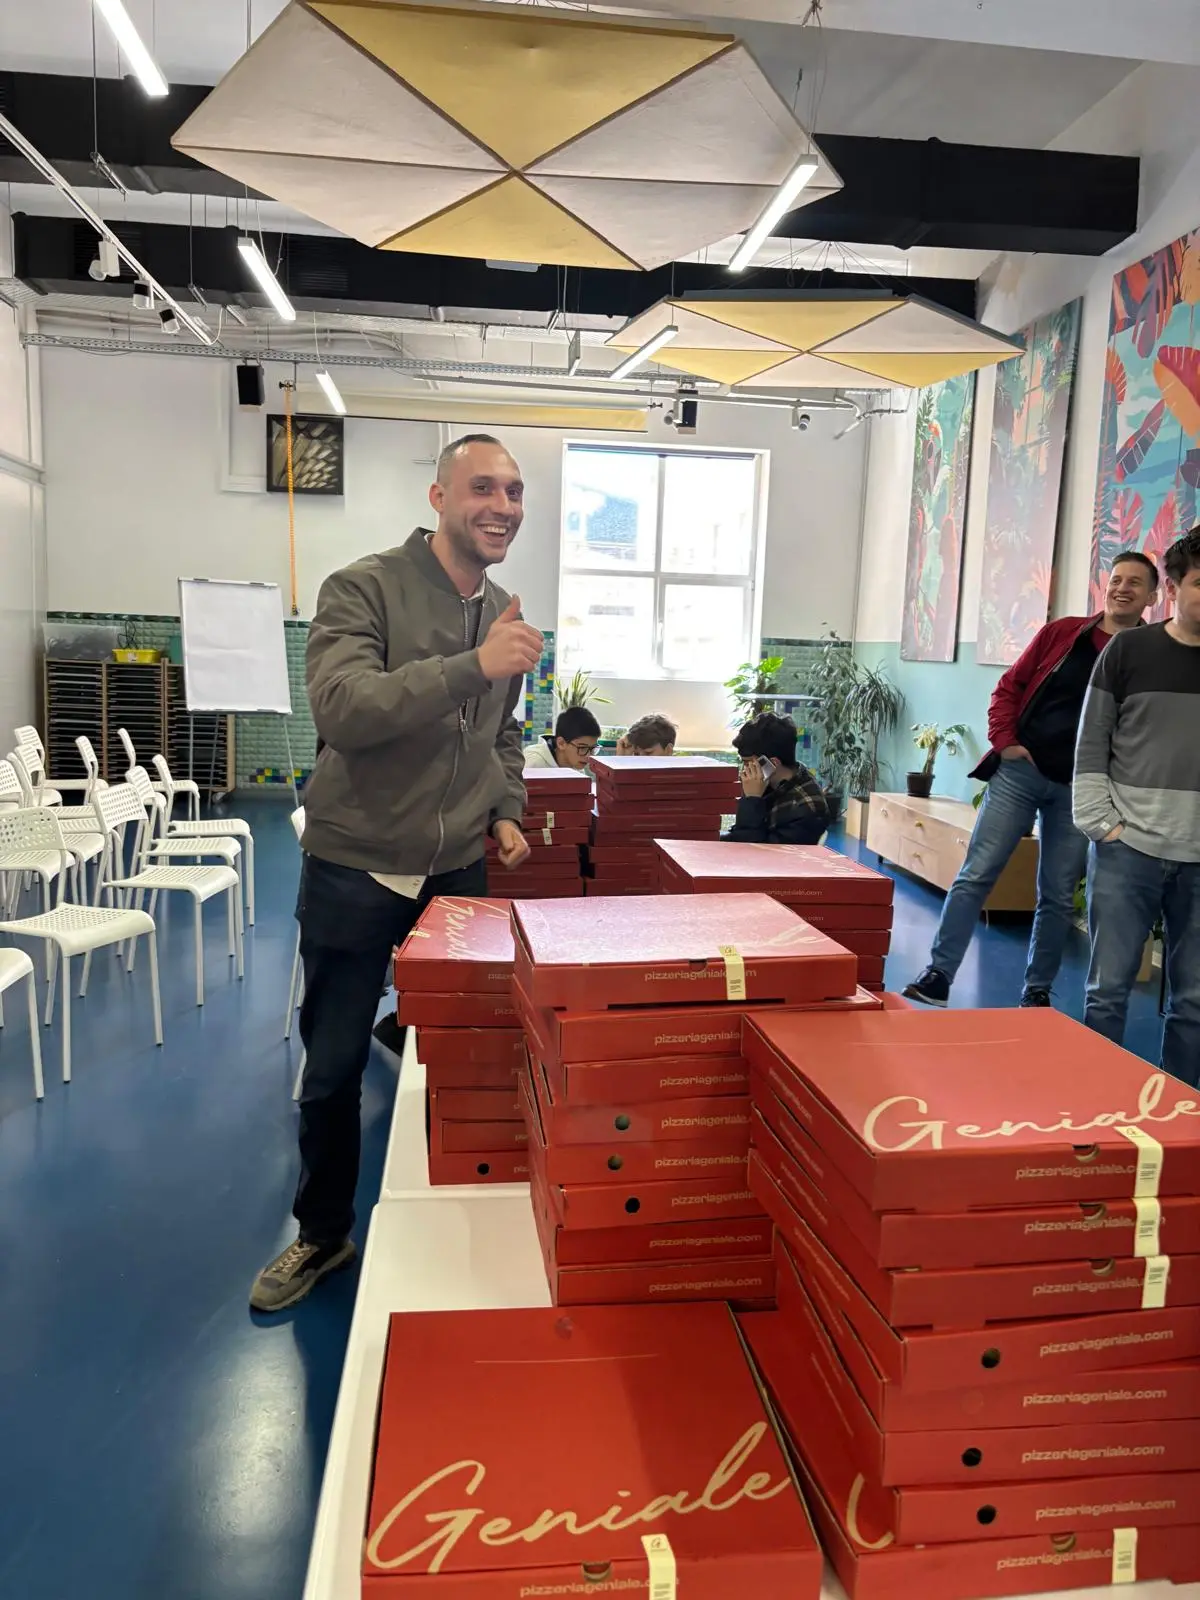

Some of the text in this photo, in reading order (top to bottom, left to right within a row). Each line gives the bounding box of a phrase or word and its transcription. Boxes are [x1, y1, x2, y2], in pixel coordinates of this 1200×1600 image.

[863, 1073, 1200, 1152] Geniale
[655, 1154, 749, 1169] pizzeriageniale.c
[1015, 1163, 1135, 1180] pizzeriageniale.c
[649, 1234, 762, 1249] pizzeriageniale.com
[649, 1276, 762, 1294] pizzeriageniale.com
[1039, 1329, 1174, 1358] pizzeriageniale.com
[1022, 1388, 1167, 1408] pizzeriageniale.com
[1021, 1444, 1166, 1464] pizzeriageniale.com
[366, 1421, 793, 1574] Geniale
[1035, 1499, 1176, 1521] pizzeriageniale.com
[996, 1547, 1113, 1571] pizzeriageniale.c
